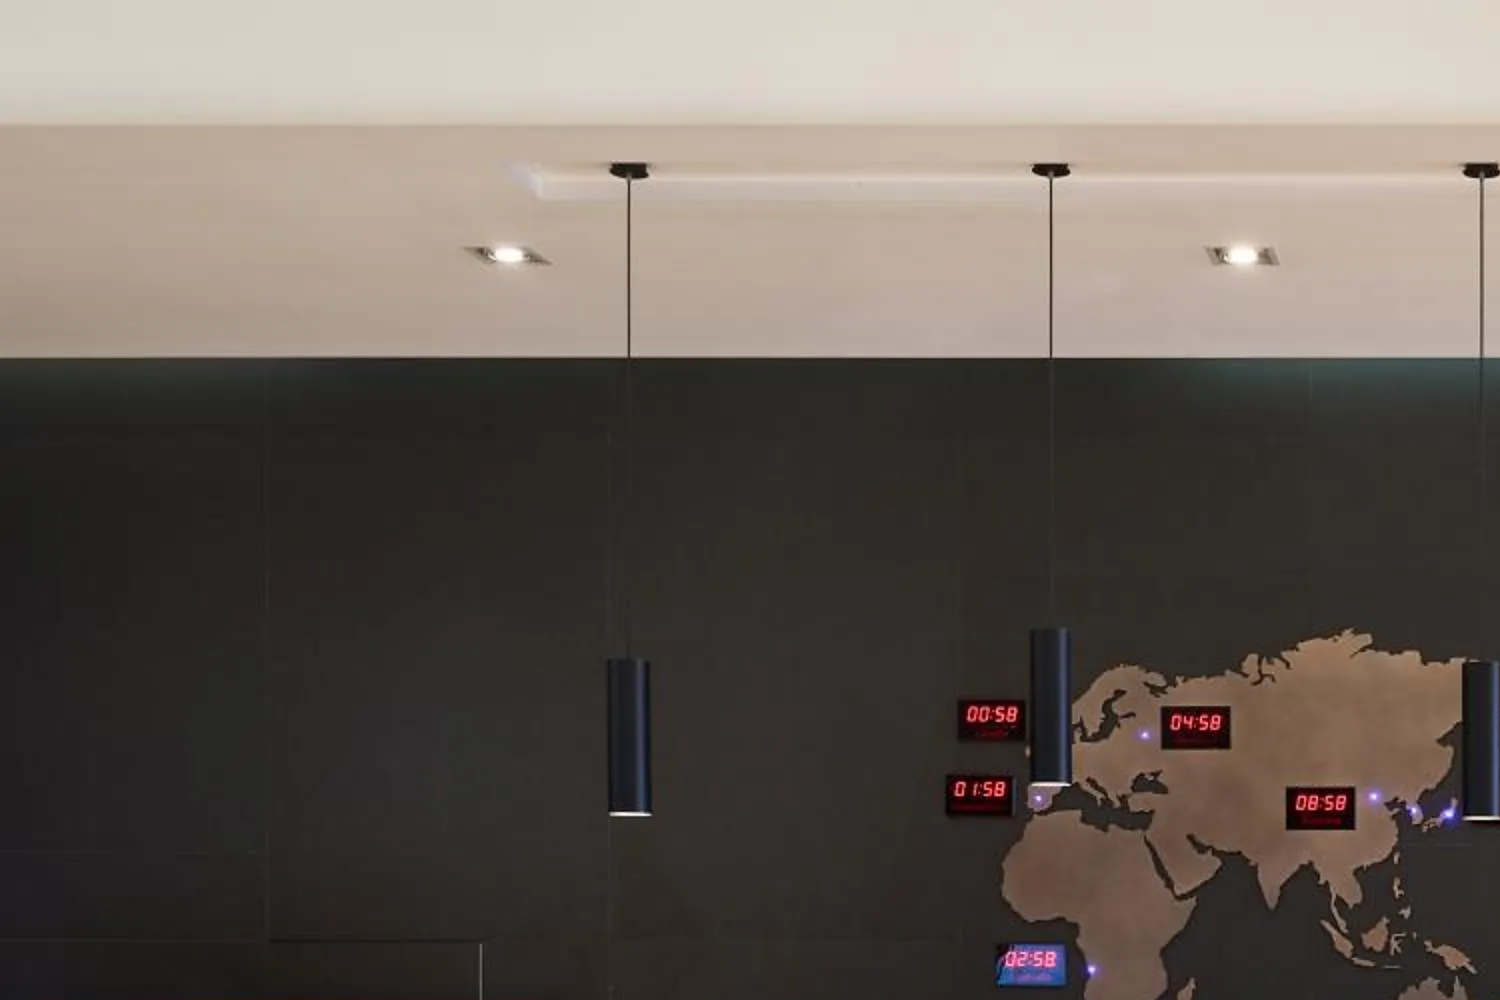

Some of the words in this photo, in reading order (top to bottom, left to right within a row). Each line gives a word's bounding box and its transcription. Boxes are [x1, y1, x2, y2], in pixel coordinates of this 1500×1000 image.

[966, 705, 1018, 723] 00:58
[1169, 713, 1222, 731] 04:58
[954, 781, 1007, 797] 01:58
[1295, 795, 1347, 811] 08:58
[1004, 951, 1057, 967] 02:58
